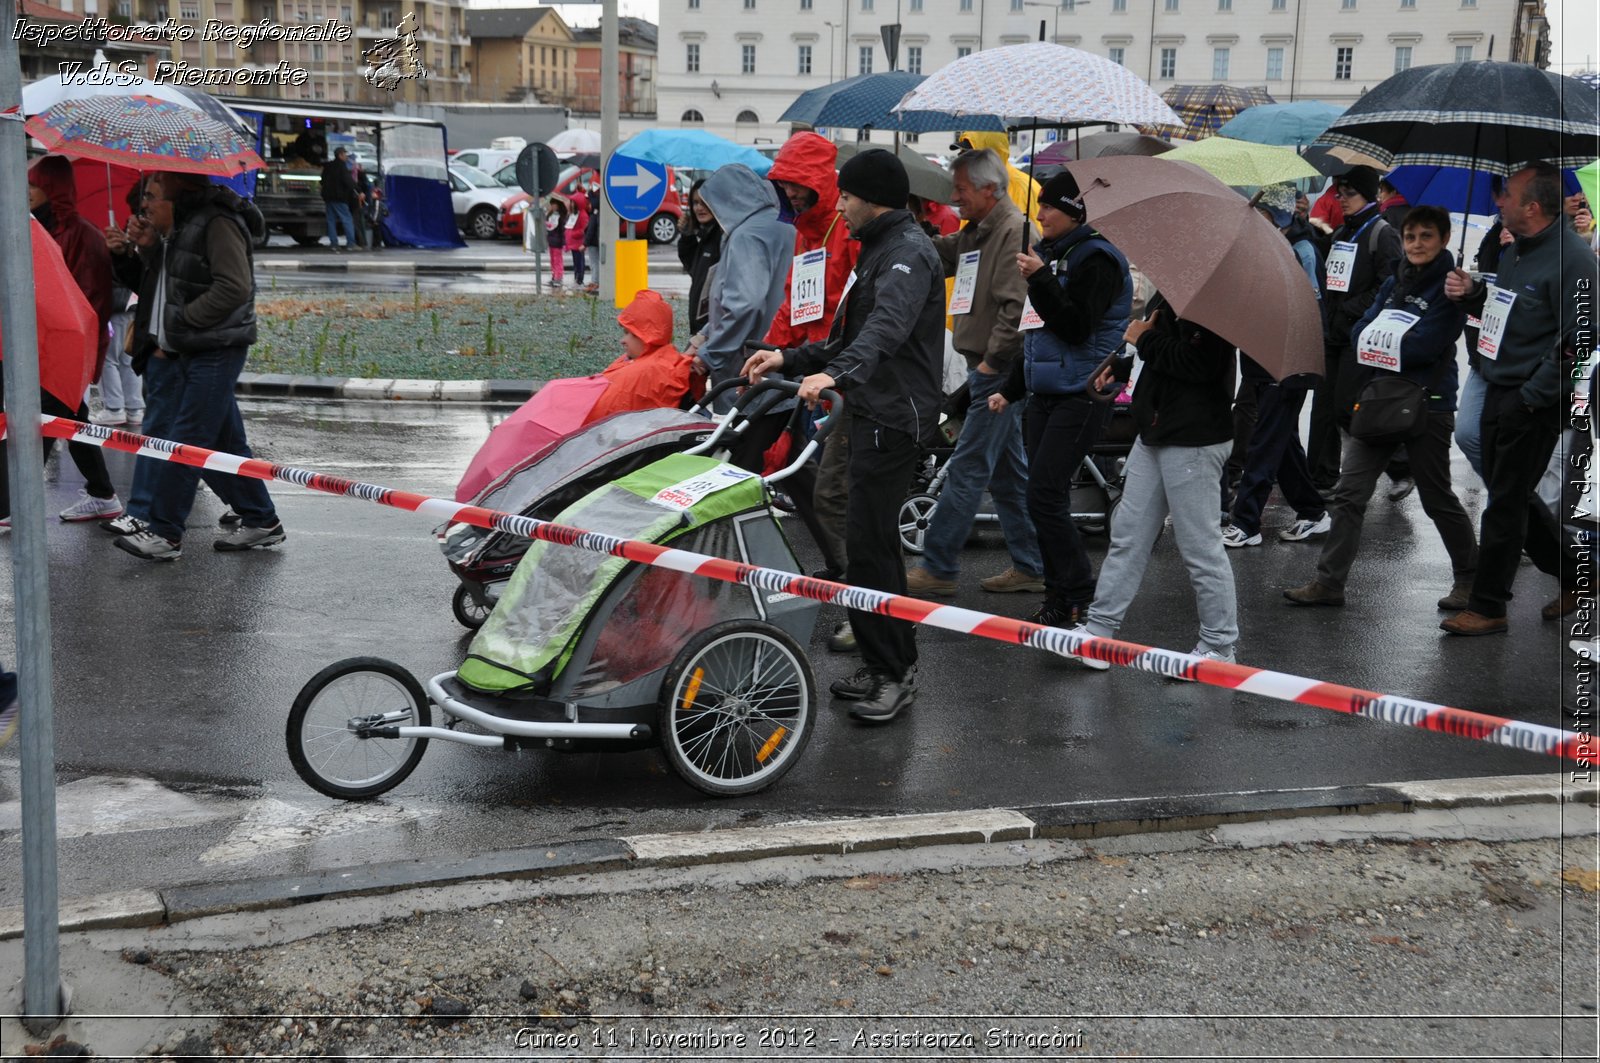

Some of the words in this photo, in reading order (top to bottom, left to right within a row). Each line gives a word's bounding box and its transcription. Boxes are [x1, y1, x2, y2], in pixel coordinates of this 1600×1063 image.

[797, 277, 817, 301] 1371
[1366, 329, 1393, 349] 2010
[735, 566, 792, 593] POLIZIA
[797, 578, 893, 616] MUNICIPALE
[1018, 625, 1083, 655] POLIZIA
[1089, 640, 1204, 680] MUNICIPALE
[1351, 694, 1428, 728] POLIZIA
